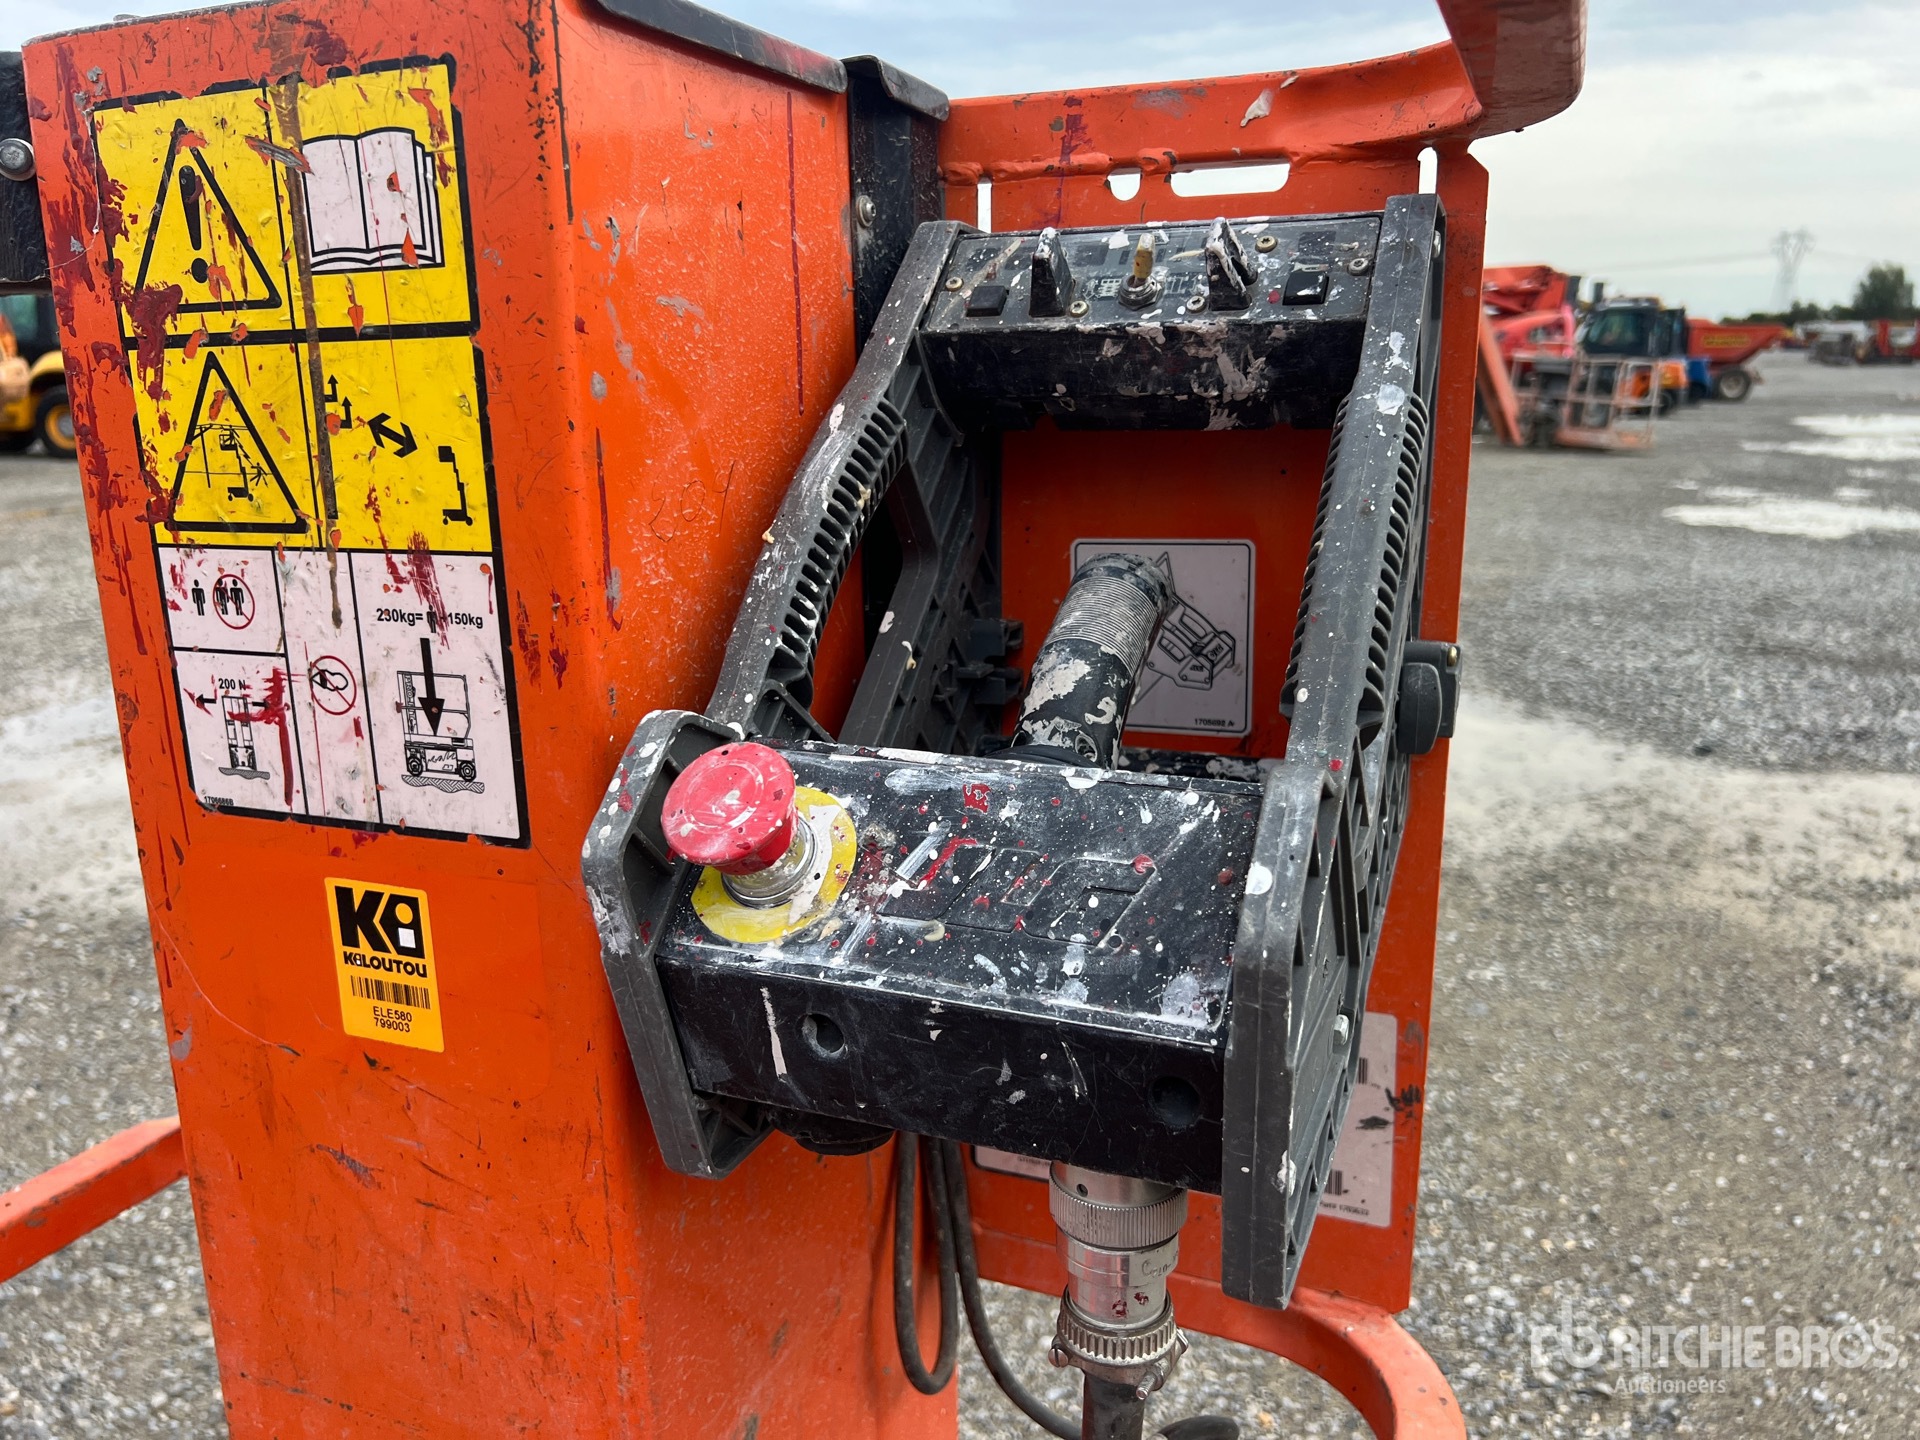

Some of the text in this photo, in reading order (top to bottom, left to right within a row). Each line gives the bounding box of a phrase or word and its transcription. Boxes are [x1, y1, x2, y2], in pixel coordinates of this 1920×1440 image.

[218, 678, 247, 690] 200 N
[372, 1005, 413, 1023] ELE580
[373, 1016, 411, 1033] 799003
